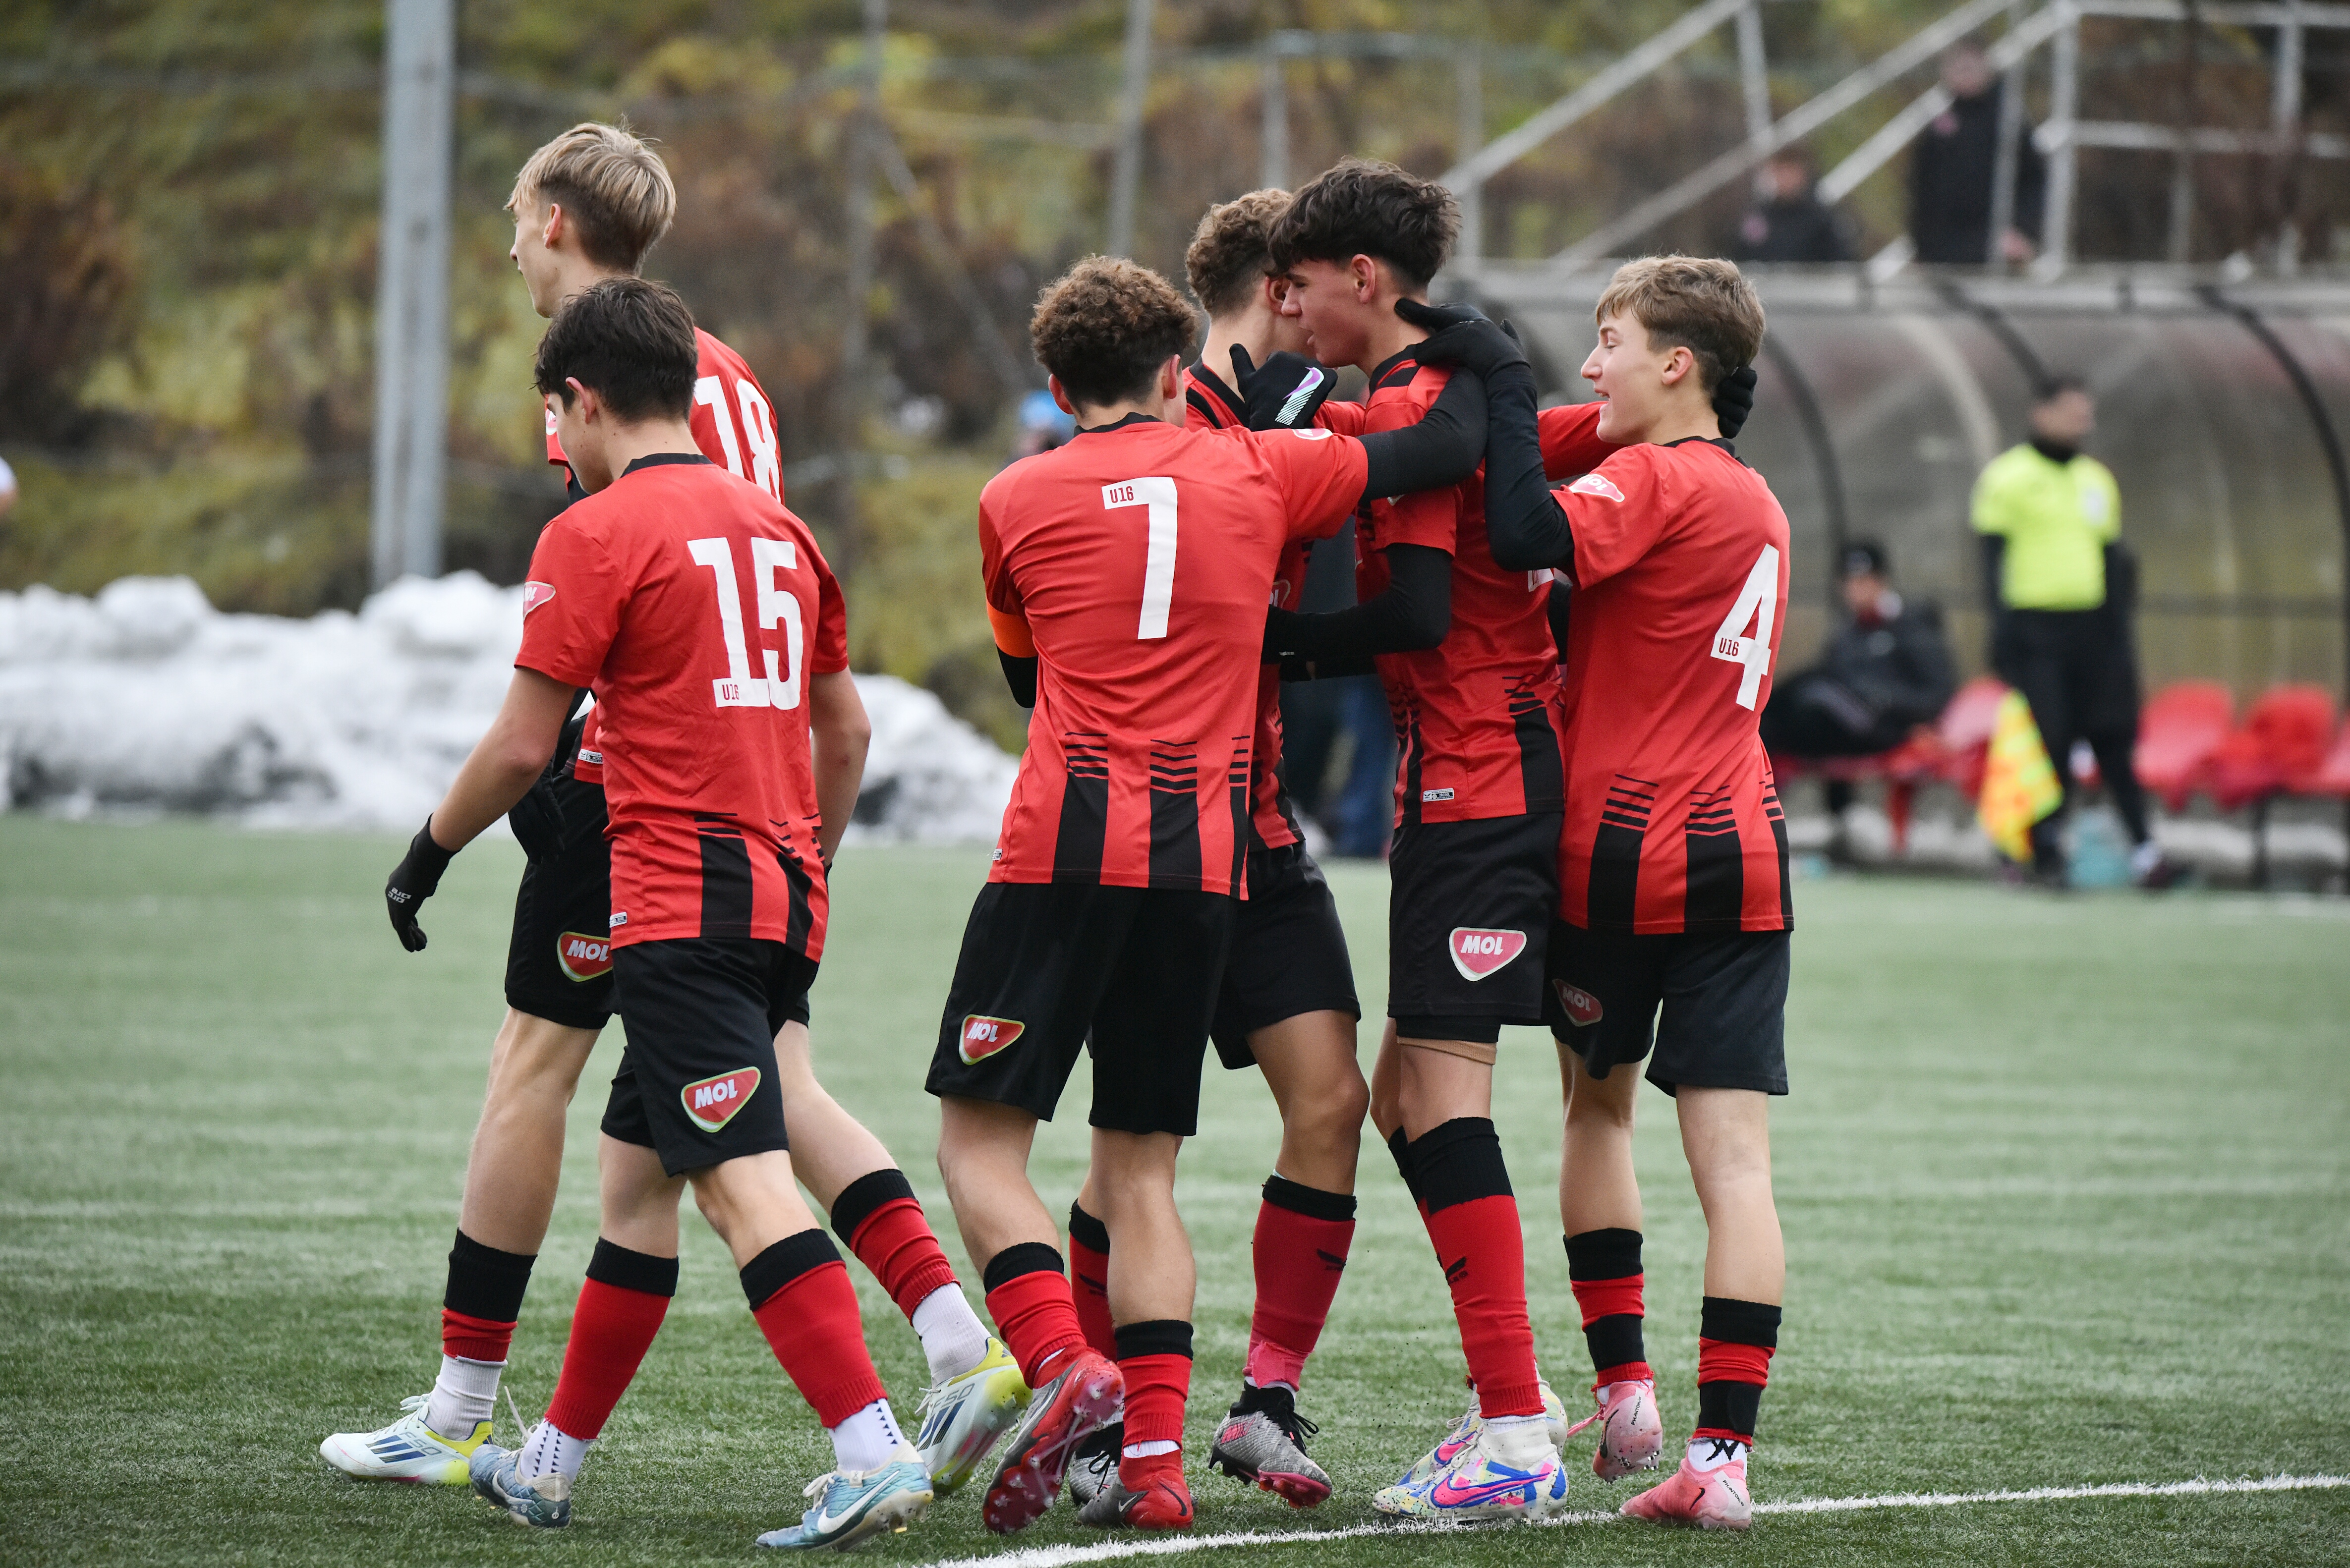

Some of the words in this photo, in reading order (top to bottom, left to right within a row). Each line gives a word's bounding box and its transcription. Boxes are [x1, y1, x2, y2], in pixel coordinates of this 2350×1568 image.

[694, 375, 781, 503] 18
[1110, 486, 1134, 503] U16
[1101, 477, 1178, 639] 7
[687, 537, 803, 710] 15
[1711, 543, 1779, 711] 4
[1719, 638, 1739, 657] U16
[722, 684, 740, 700] U16
[567, 940, 609, 961] MOL
[1461, 935, 1503, 955] MOL
[1563, 986, 1591, 1012] MOL
[967, 1022, 999, 1042] MOL
[695, 1079, 738, 1109] MOL
[1631, 1401, 1641, 1425] PHANTOM
[399, 1432, 443, 1456] F50
[1722, 1480, 1741, 1503] PHANTOM
